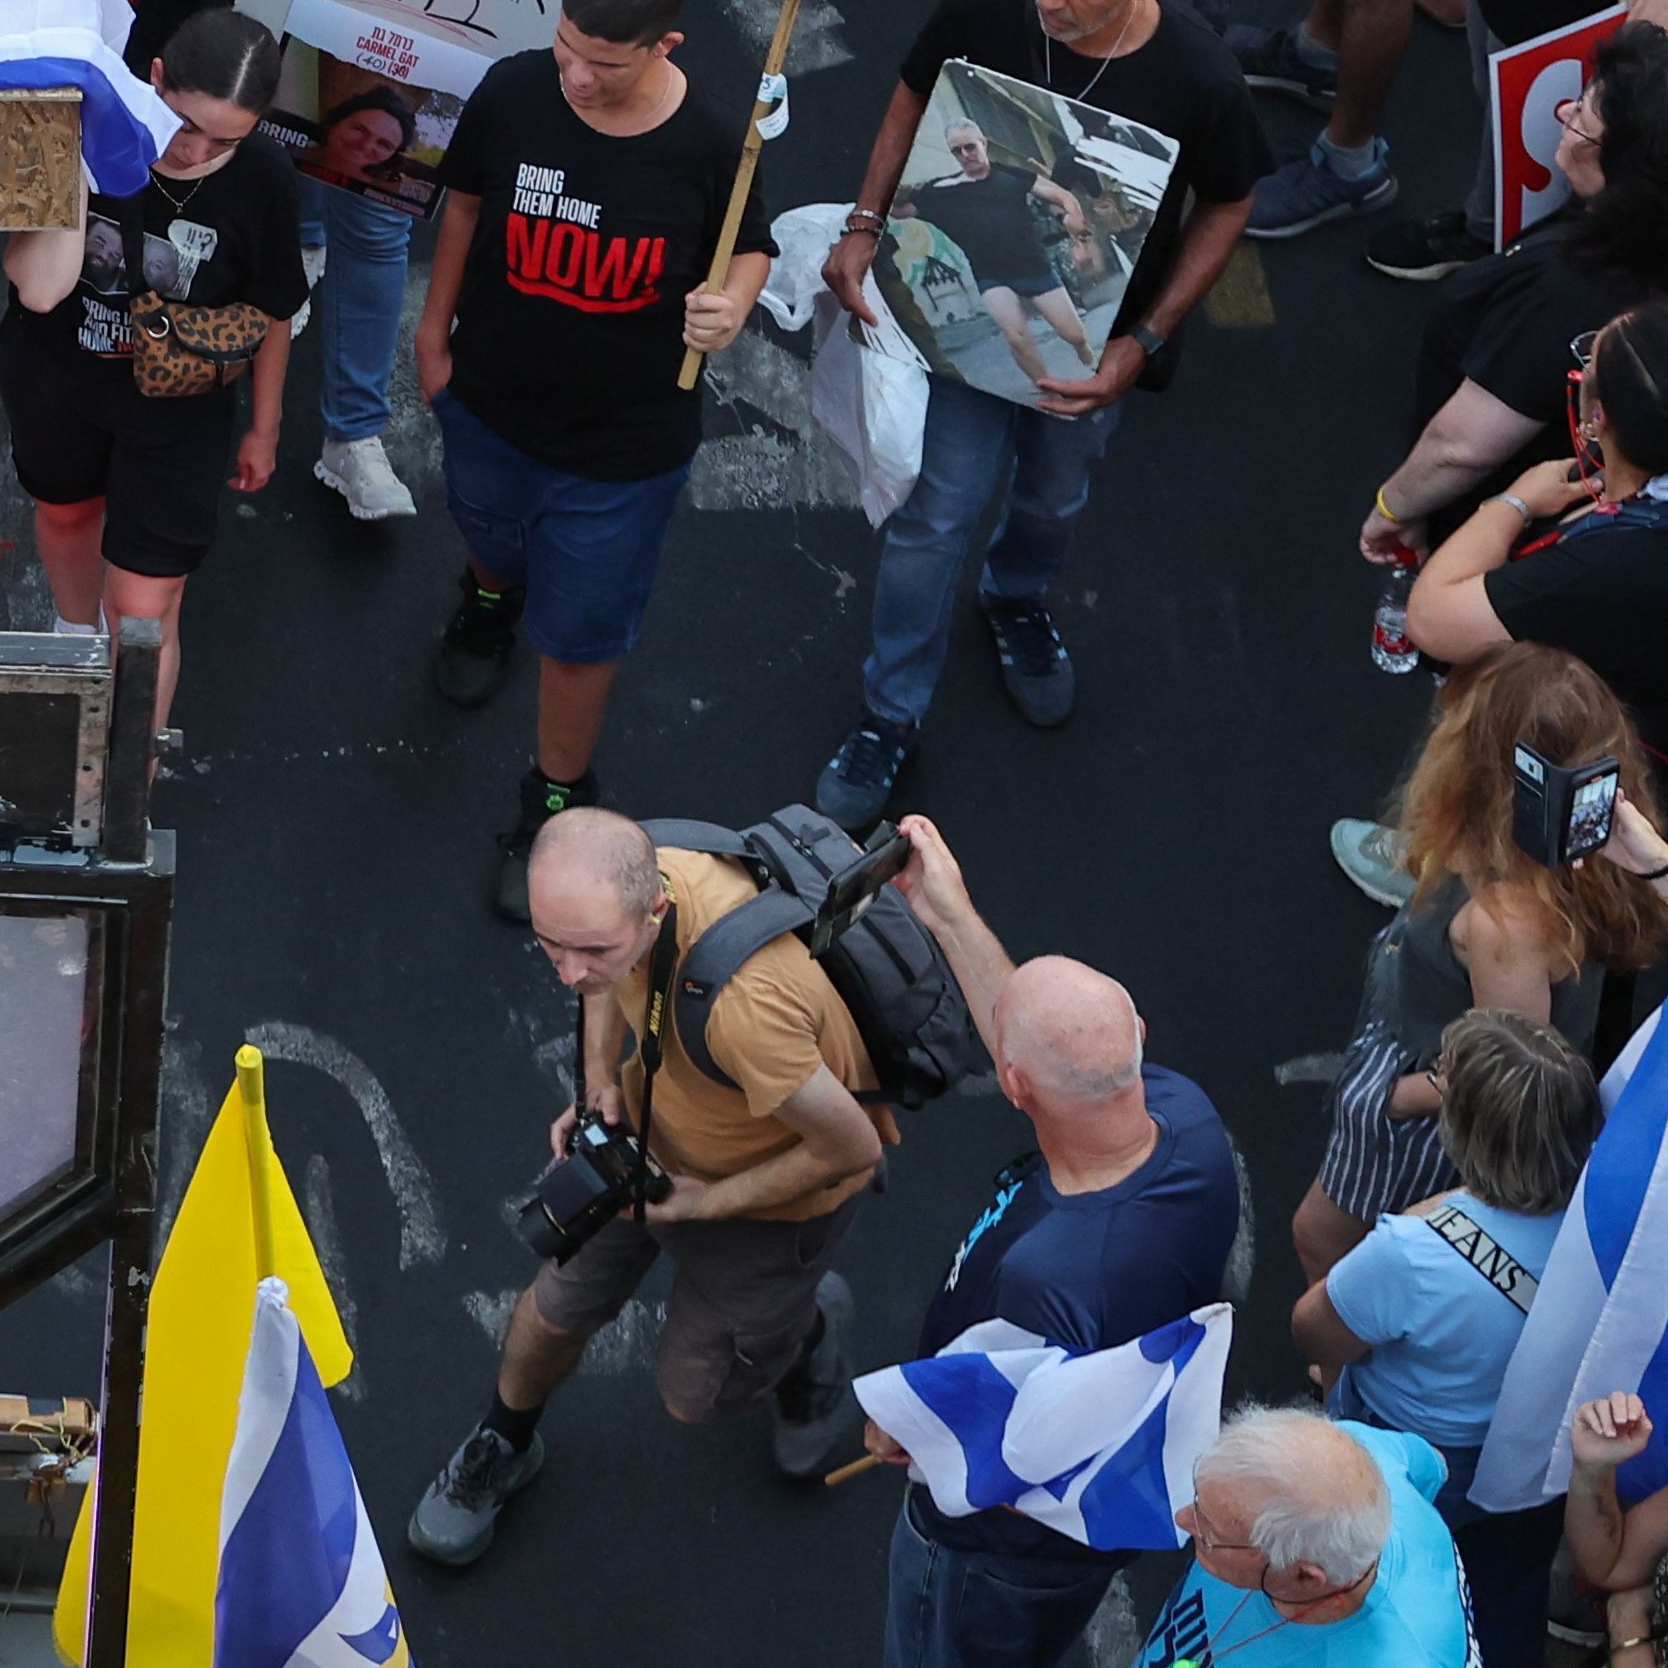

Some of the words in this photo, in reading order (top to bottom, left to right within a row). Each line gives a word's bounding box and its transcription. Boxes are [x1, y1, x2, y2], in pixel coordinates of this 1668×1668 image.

[356, 36, 396, 61] CARMEL
[398, 50, 420, 68] GAT
[256, 120, 310, 149] BRING
[515, 163, 565, 194] BRING
[512, 186, 553, 217] THEM
[556, 197, 602, 229] HOME
[505, 213, 665, 299] NOW!
[81, 296, 121, 326] BRING
[78, 326, 116, 352] HOME
